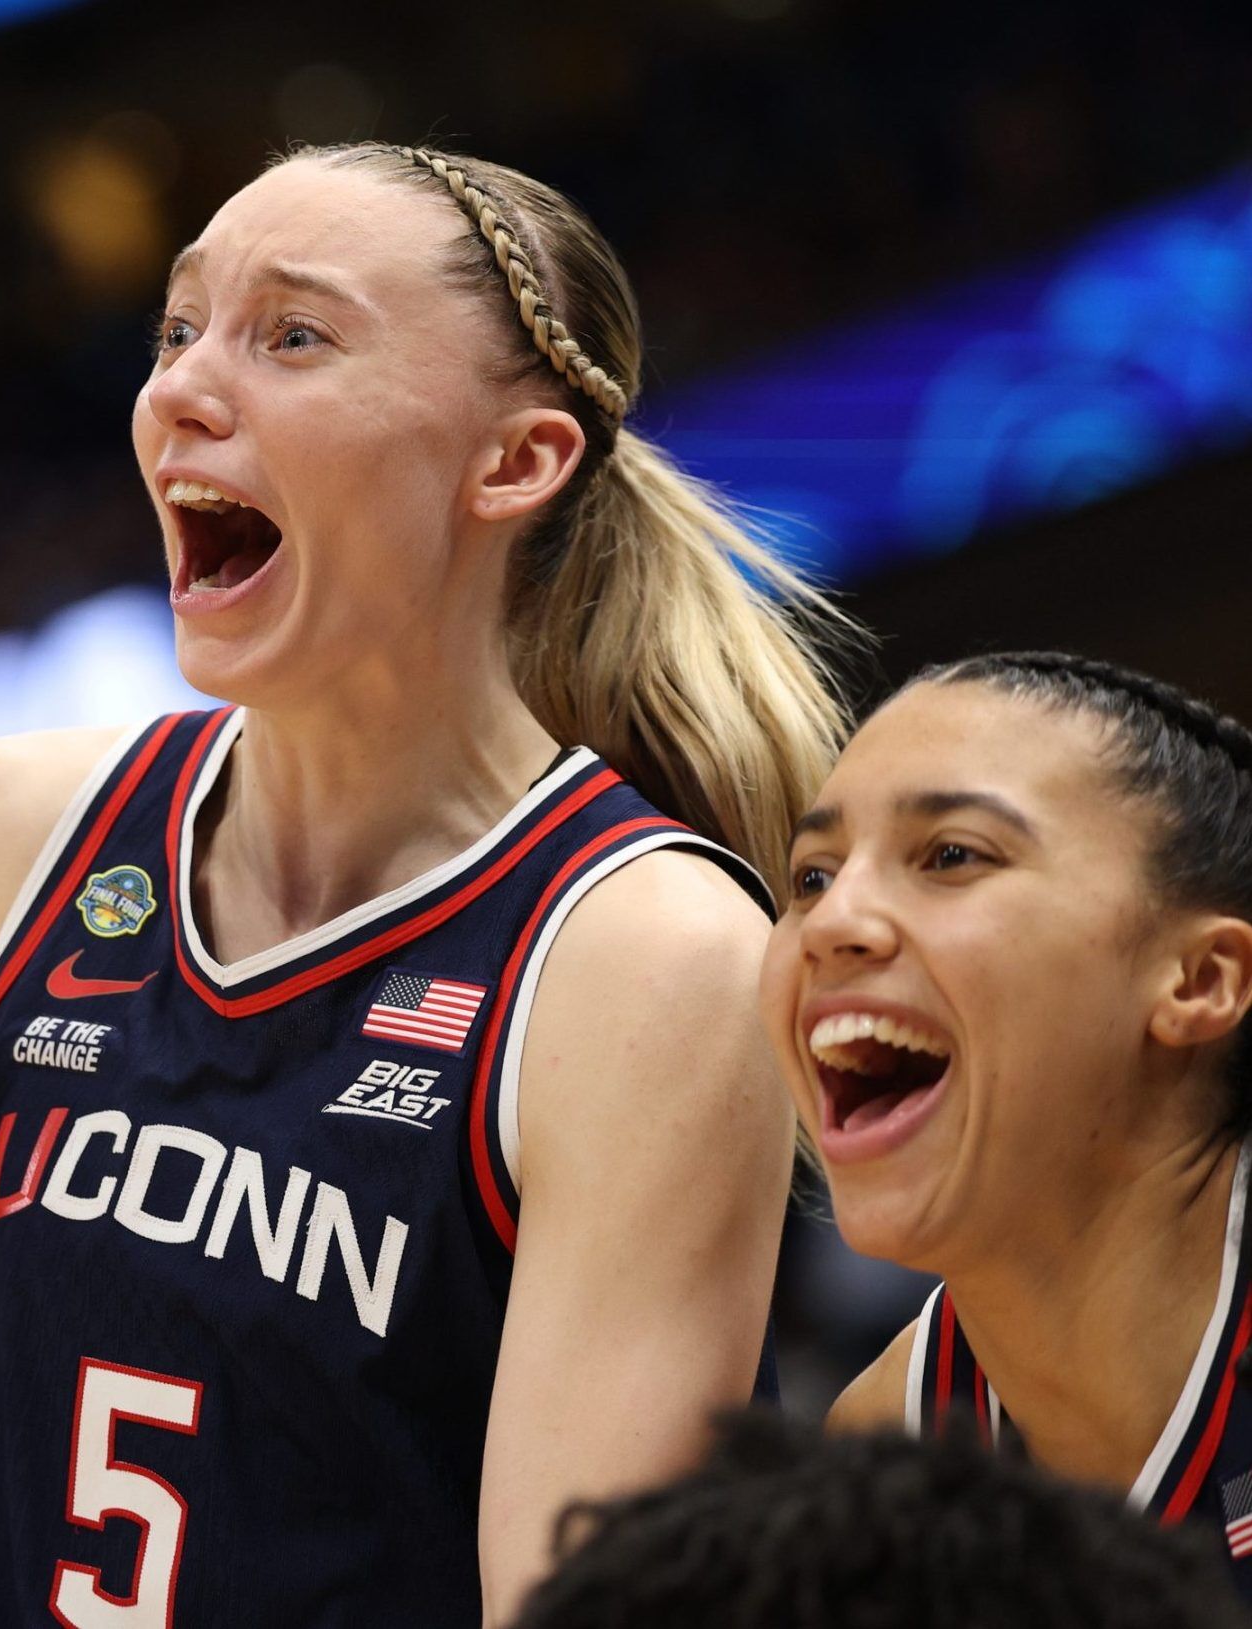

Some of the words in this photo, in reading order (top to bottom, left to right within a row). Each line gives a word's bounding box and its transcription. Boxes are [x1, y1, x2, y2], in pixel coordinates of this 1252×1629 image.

[87, 886, 120, 907] FINAL
[115, 896, 145, 922] FOUR
[24, 1015, 65, 1038] BE
[60, 1020, 112, 1045] THE
[12, 1036, 102, 1073] CHANGE
[356, 1059, 442, 1093] BIG
[336, 1082, 452, 1120] EAST
[48, 1355, 204, 1629] 5
